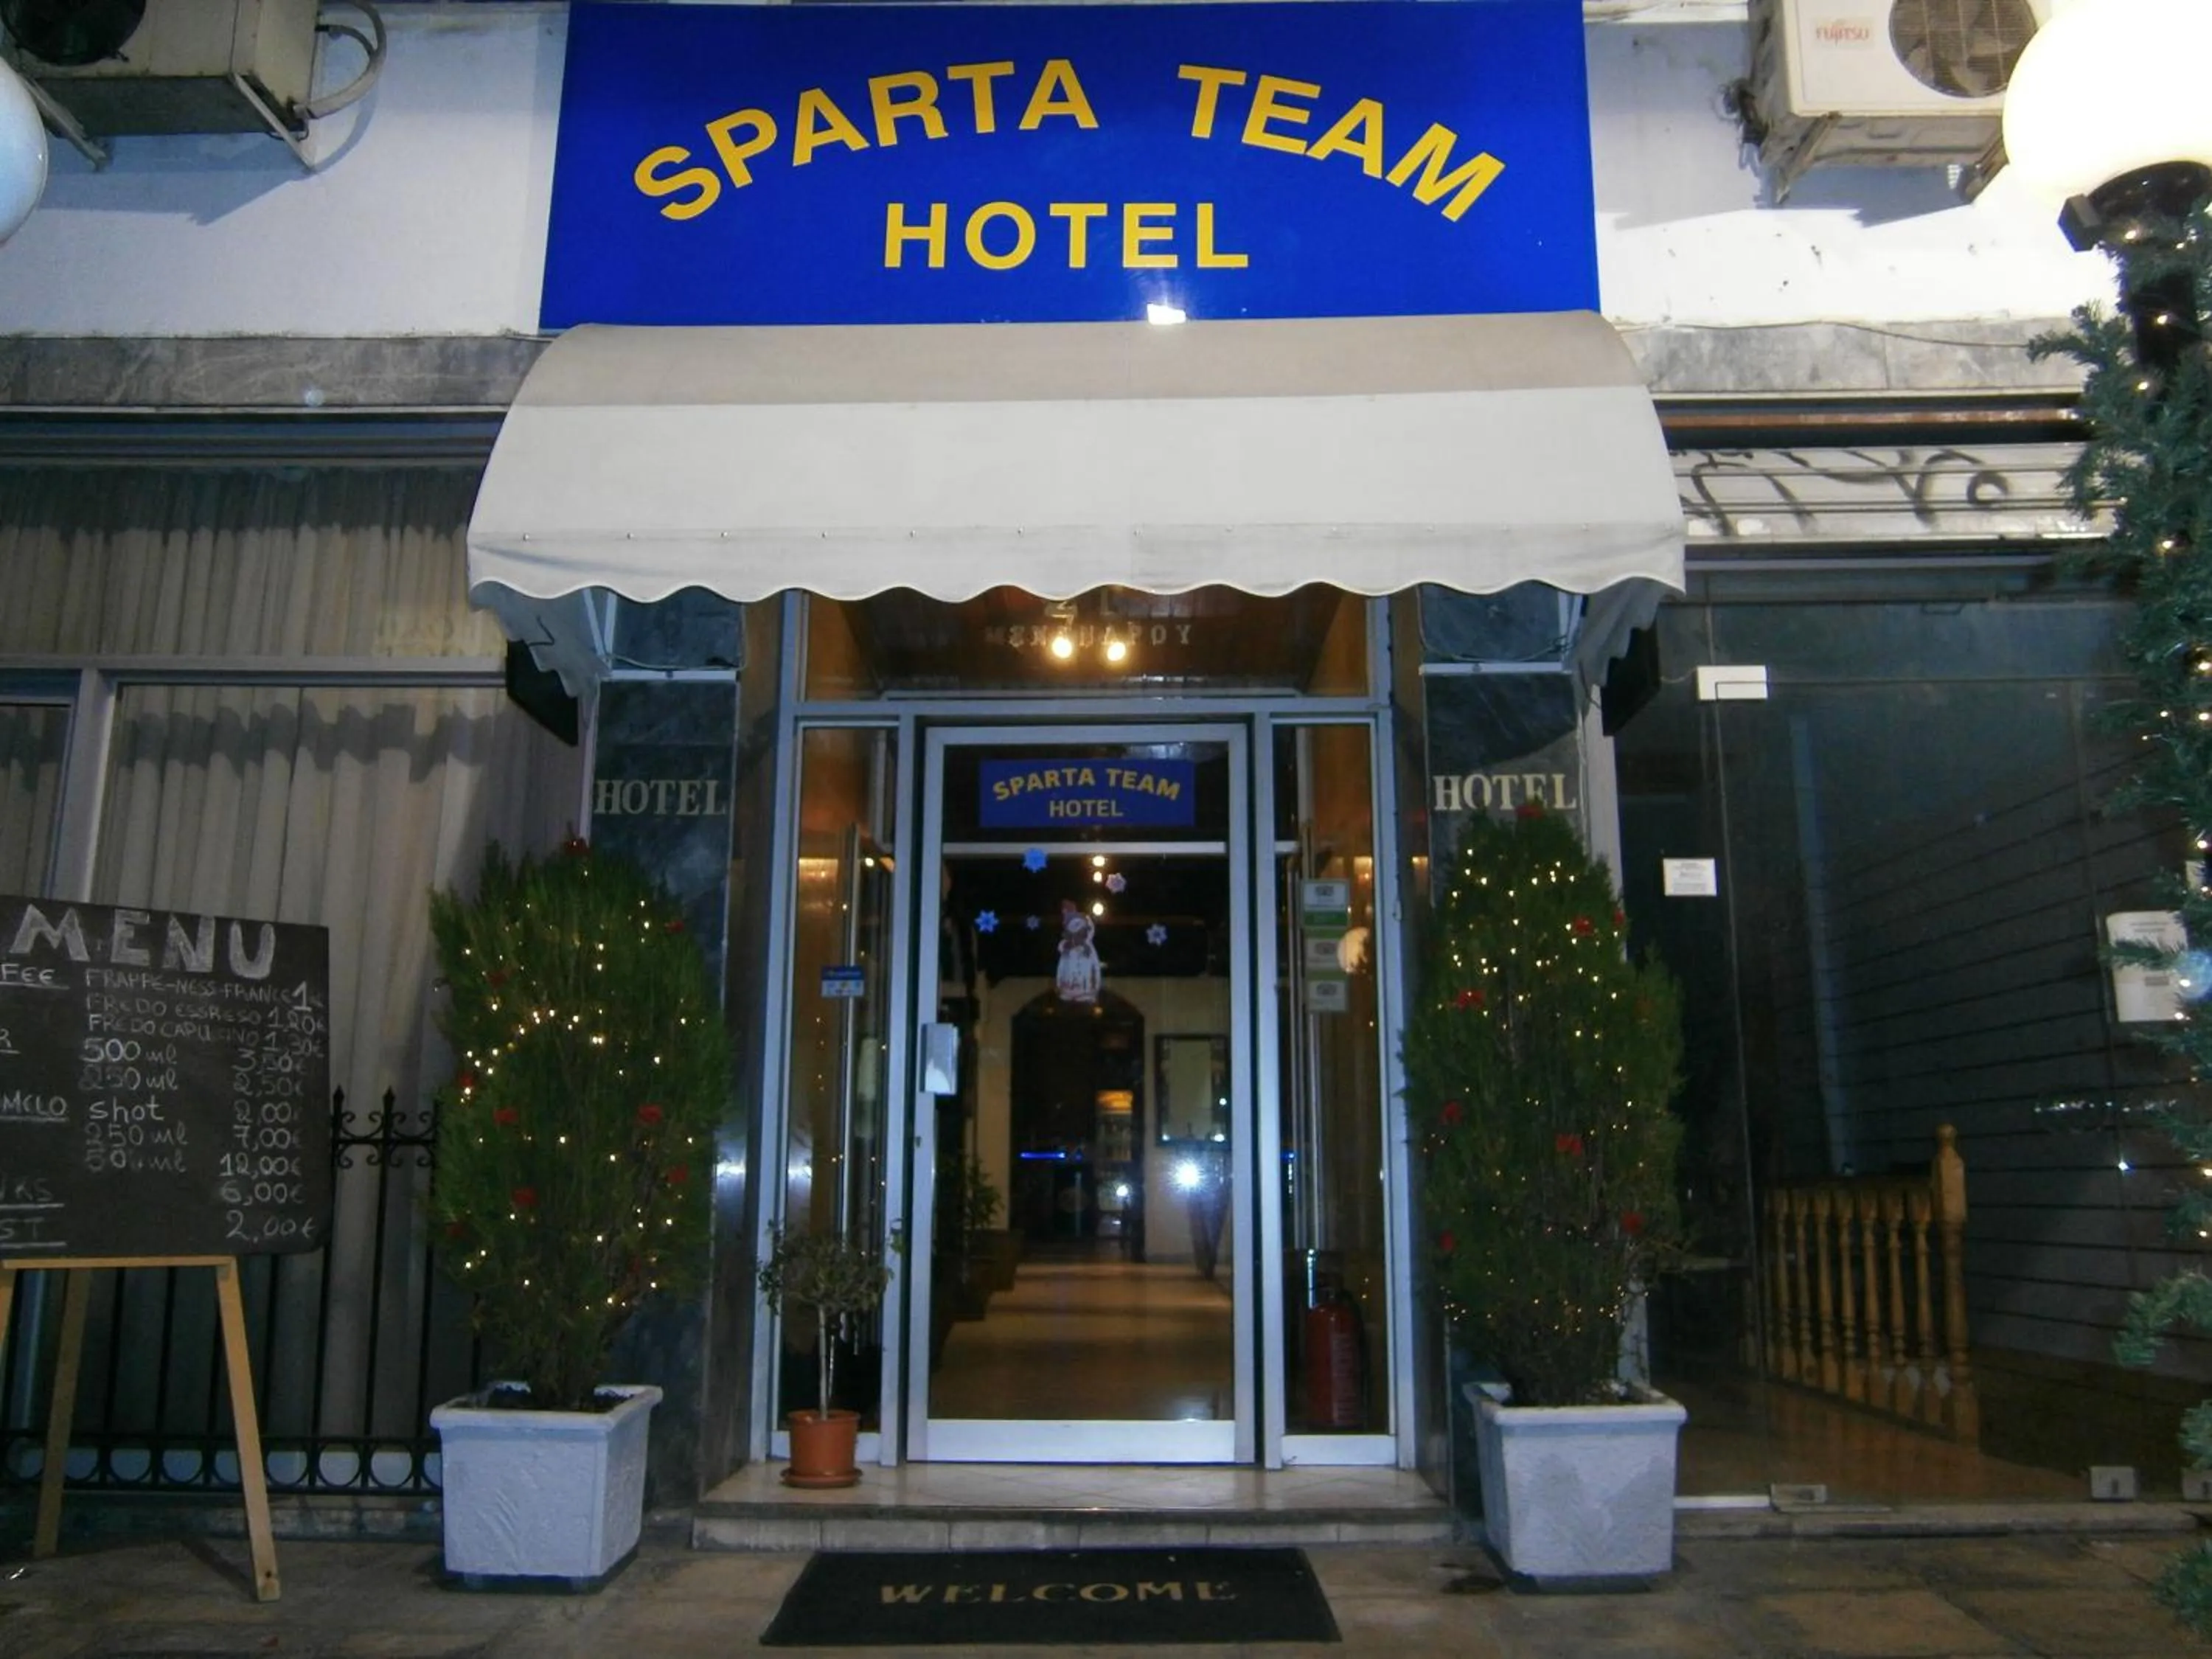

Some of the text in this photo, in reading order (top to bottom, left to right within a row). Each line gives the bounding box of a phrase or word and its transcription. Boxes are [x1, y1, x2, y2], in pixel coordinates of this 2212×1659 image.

[1816, 24, 1869, 47] FUJITSU
[634, 59, 1504, 223] SPARTA TEAM
[886, 203, 1248, 268] HOTEL
[594, 779, 726, 815] HOTEL
[992, 768, 1180, 801] SPARTA TEAM
[1433, 773, 1577, 810] HOTEL
[1048, 799, 1124, 818] HOTEL
[9, 903, 276, 979] MENU
[80, 1038, 141, 1062] 500
[89, 1094, 164, 1123] shot
[880, 1582, 1238, 1603] WELCOME
